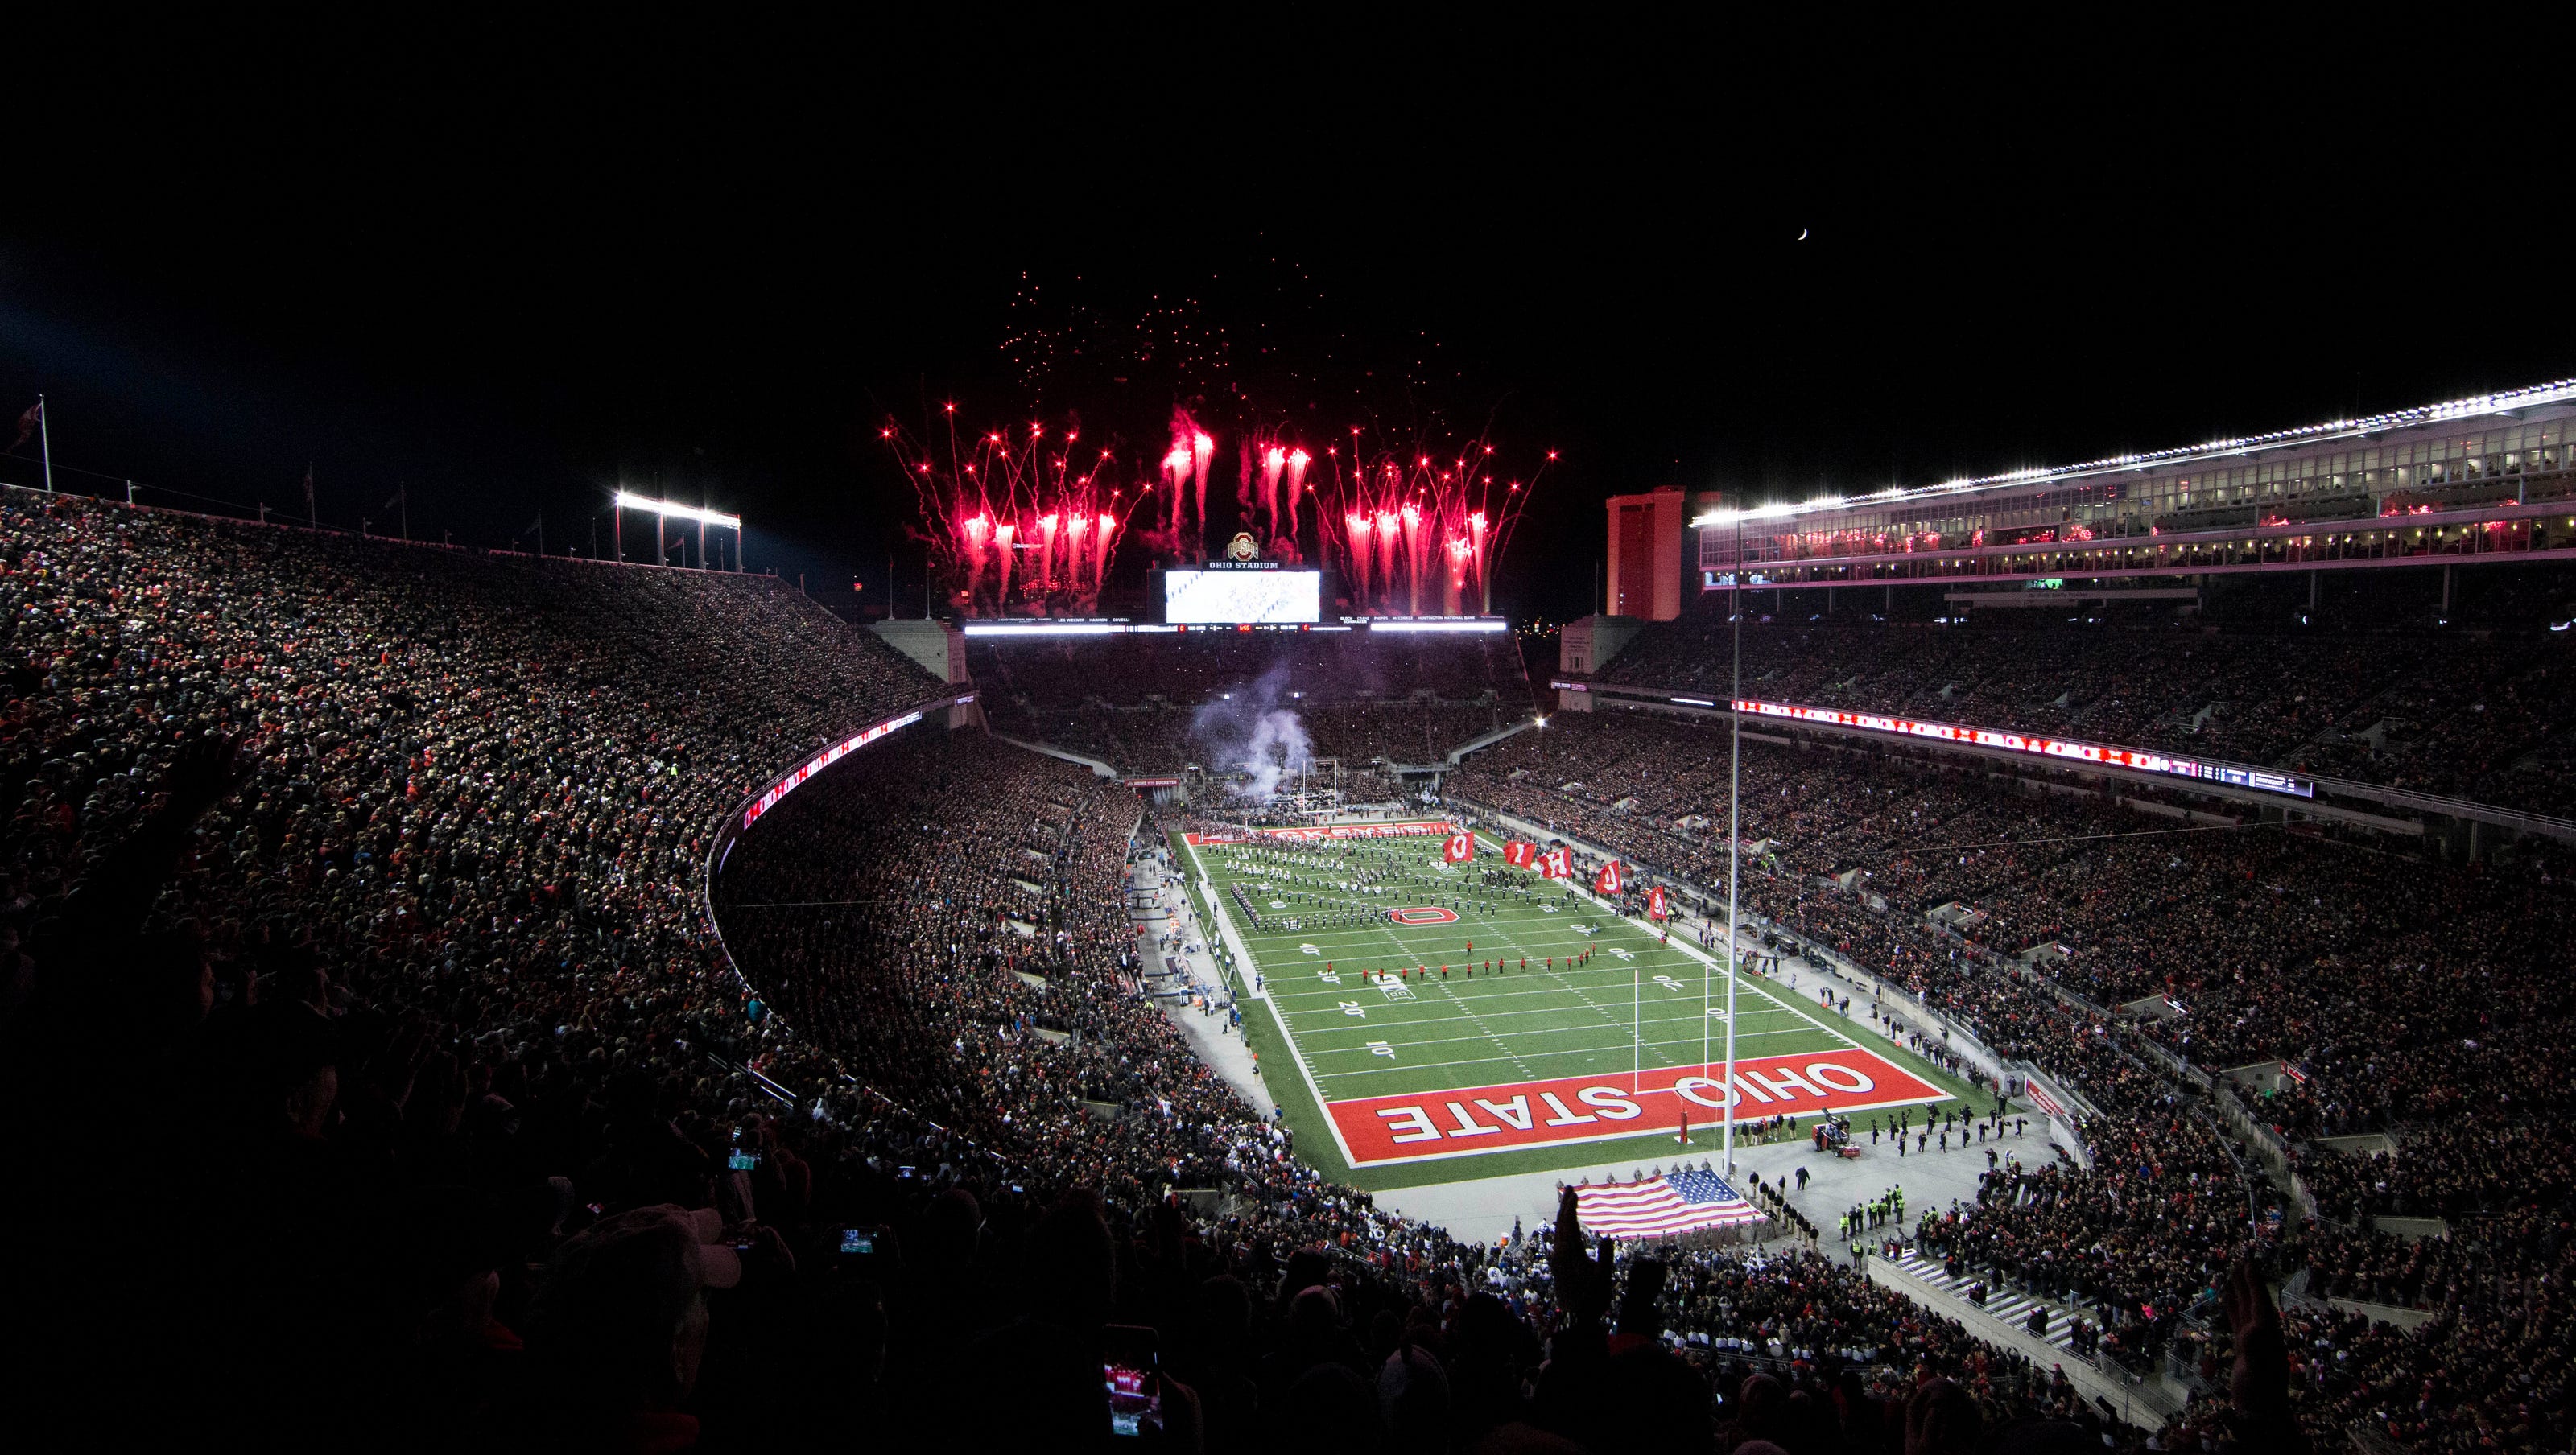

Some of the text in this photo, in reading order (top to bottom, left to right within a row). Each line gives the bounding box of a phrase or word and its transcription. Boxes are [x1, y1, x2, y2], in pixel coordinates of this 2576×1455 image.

[1451, 835, 1468, 859] O
[1514, 843, 1525, 864] I
[1546, 849, 1567, 877] H
[1299, 943, 1320, 954] 40
[1653, 975, 1685, 989] 20
[1338, 1000, 1364, 1016] 20
[1365, 1040, 1393, 1056] 10
[1375, 1062, 1876, 1144] OHIO STATE
